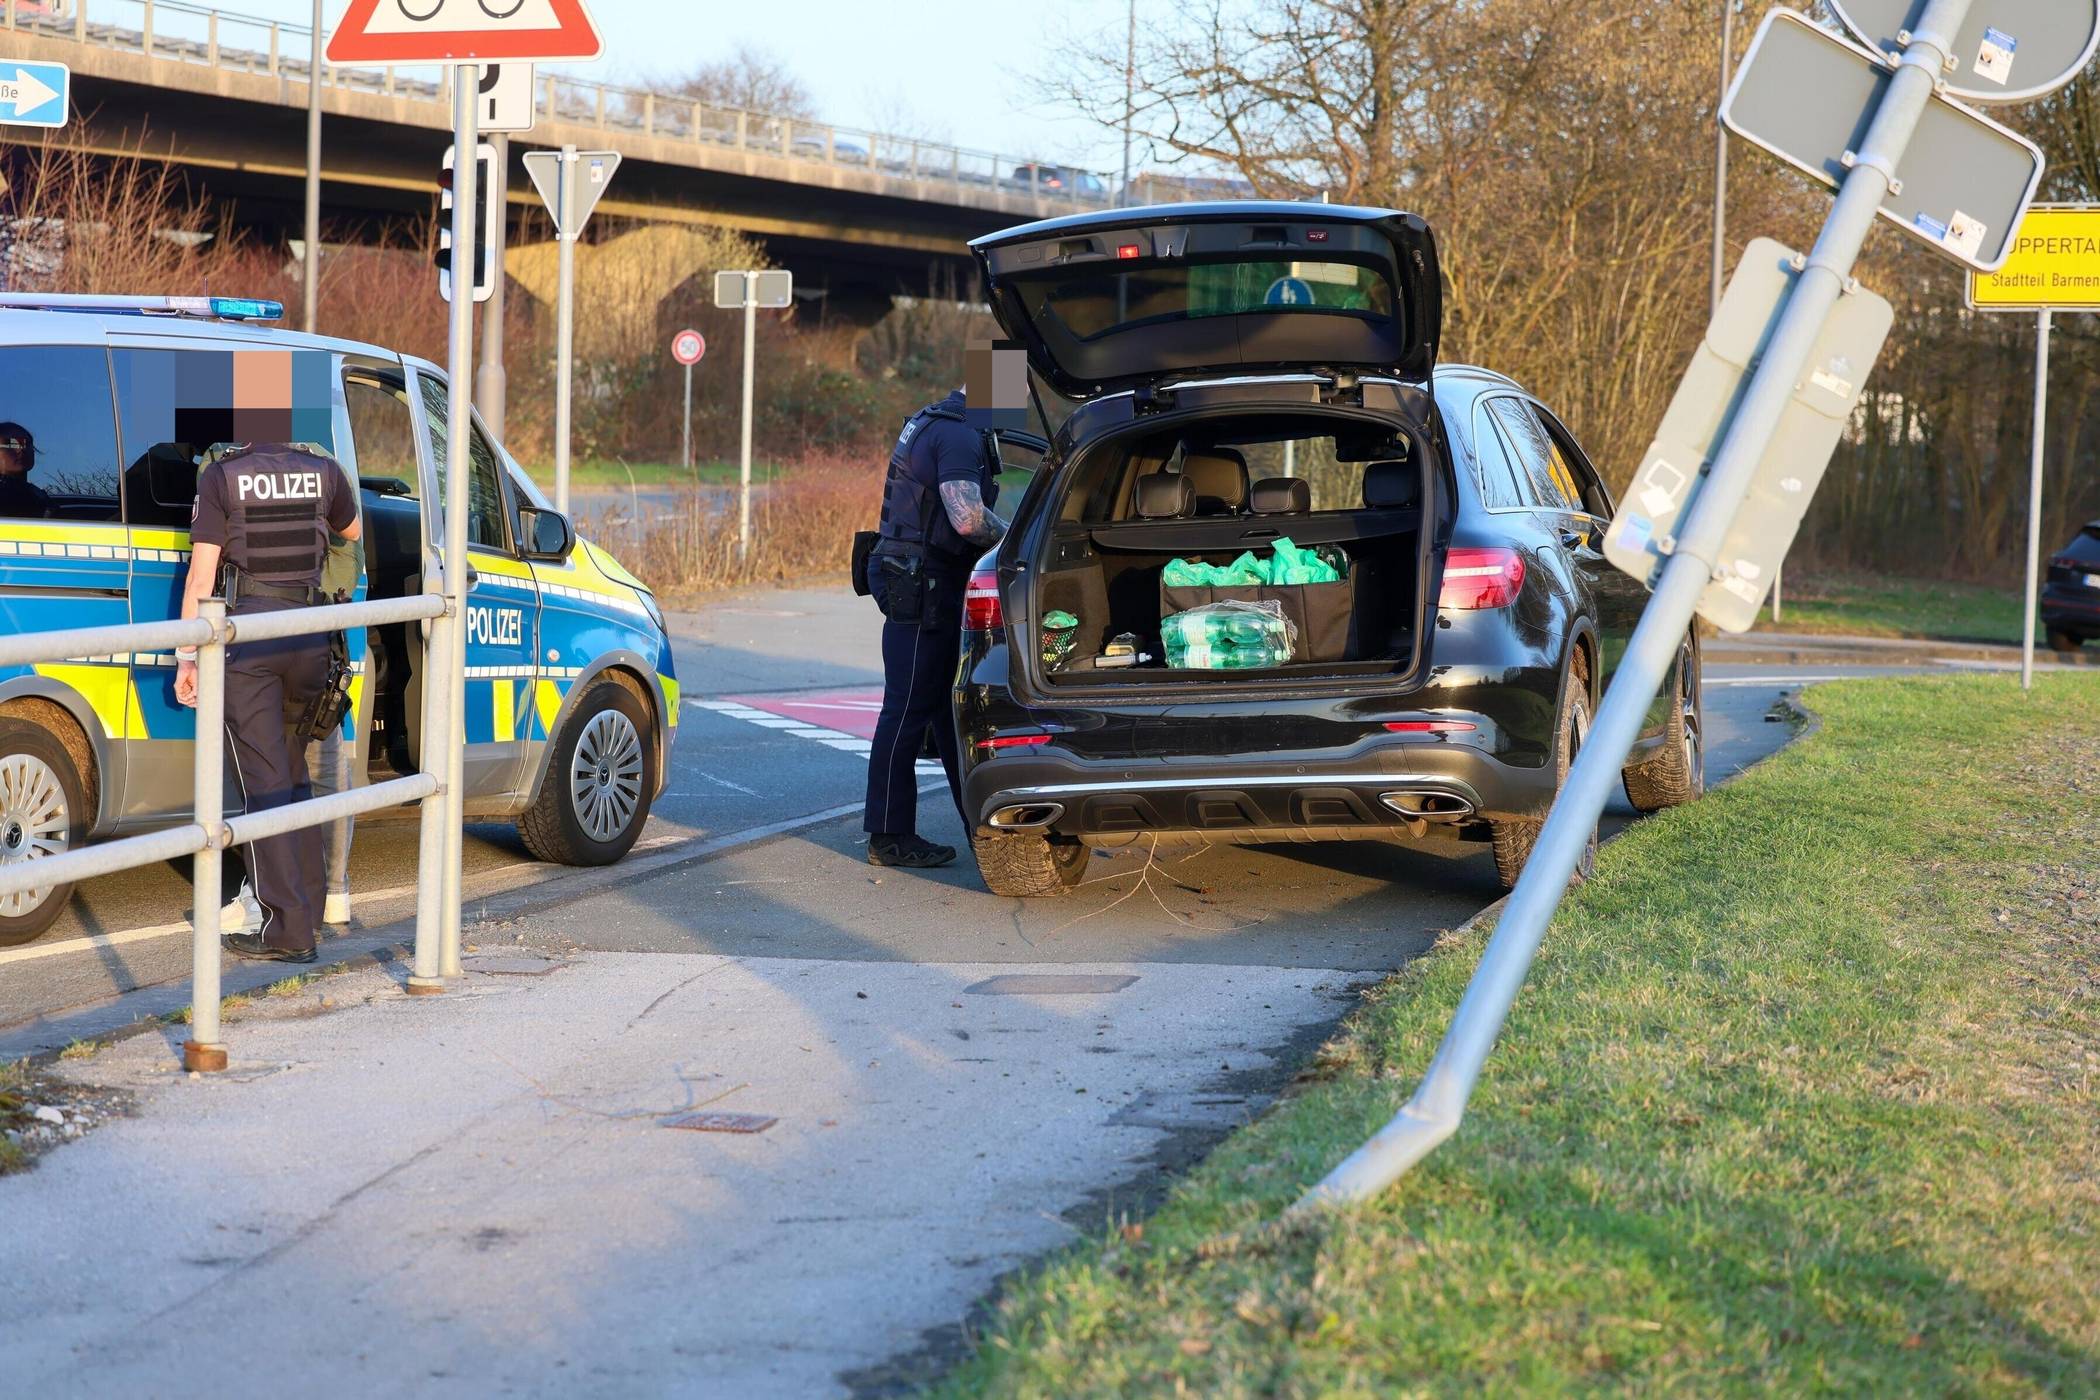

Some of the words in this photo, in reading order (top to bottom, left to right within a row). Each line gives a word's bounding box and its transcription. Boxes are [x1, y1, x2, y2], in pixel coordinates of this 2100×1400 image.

[1991, 272, 2045, 287] Stadtteil
[2052, 272, 2099, 287] Barmen
[237, 472, 322, 500] POLIZEI
[467, 606, 522, 645] POLIZEI
